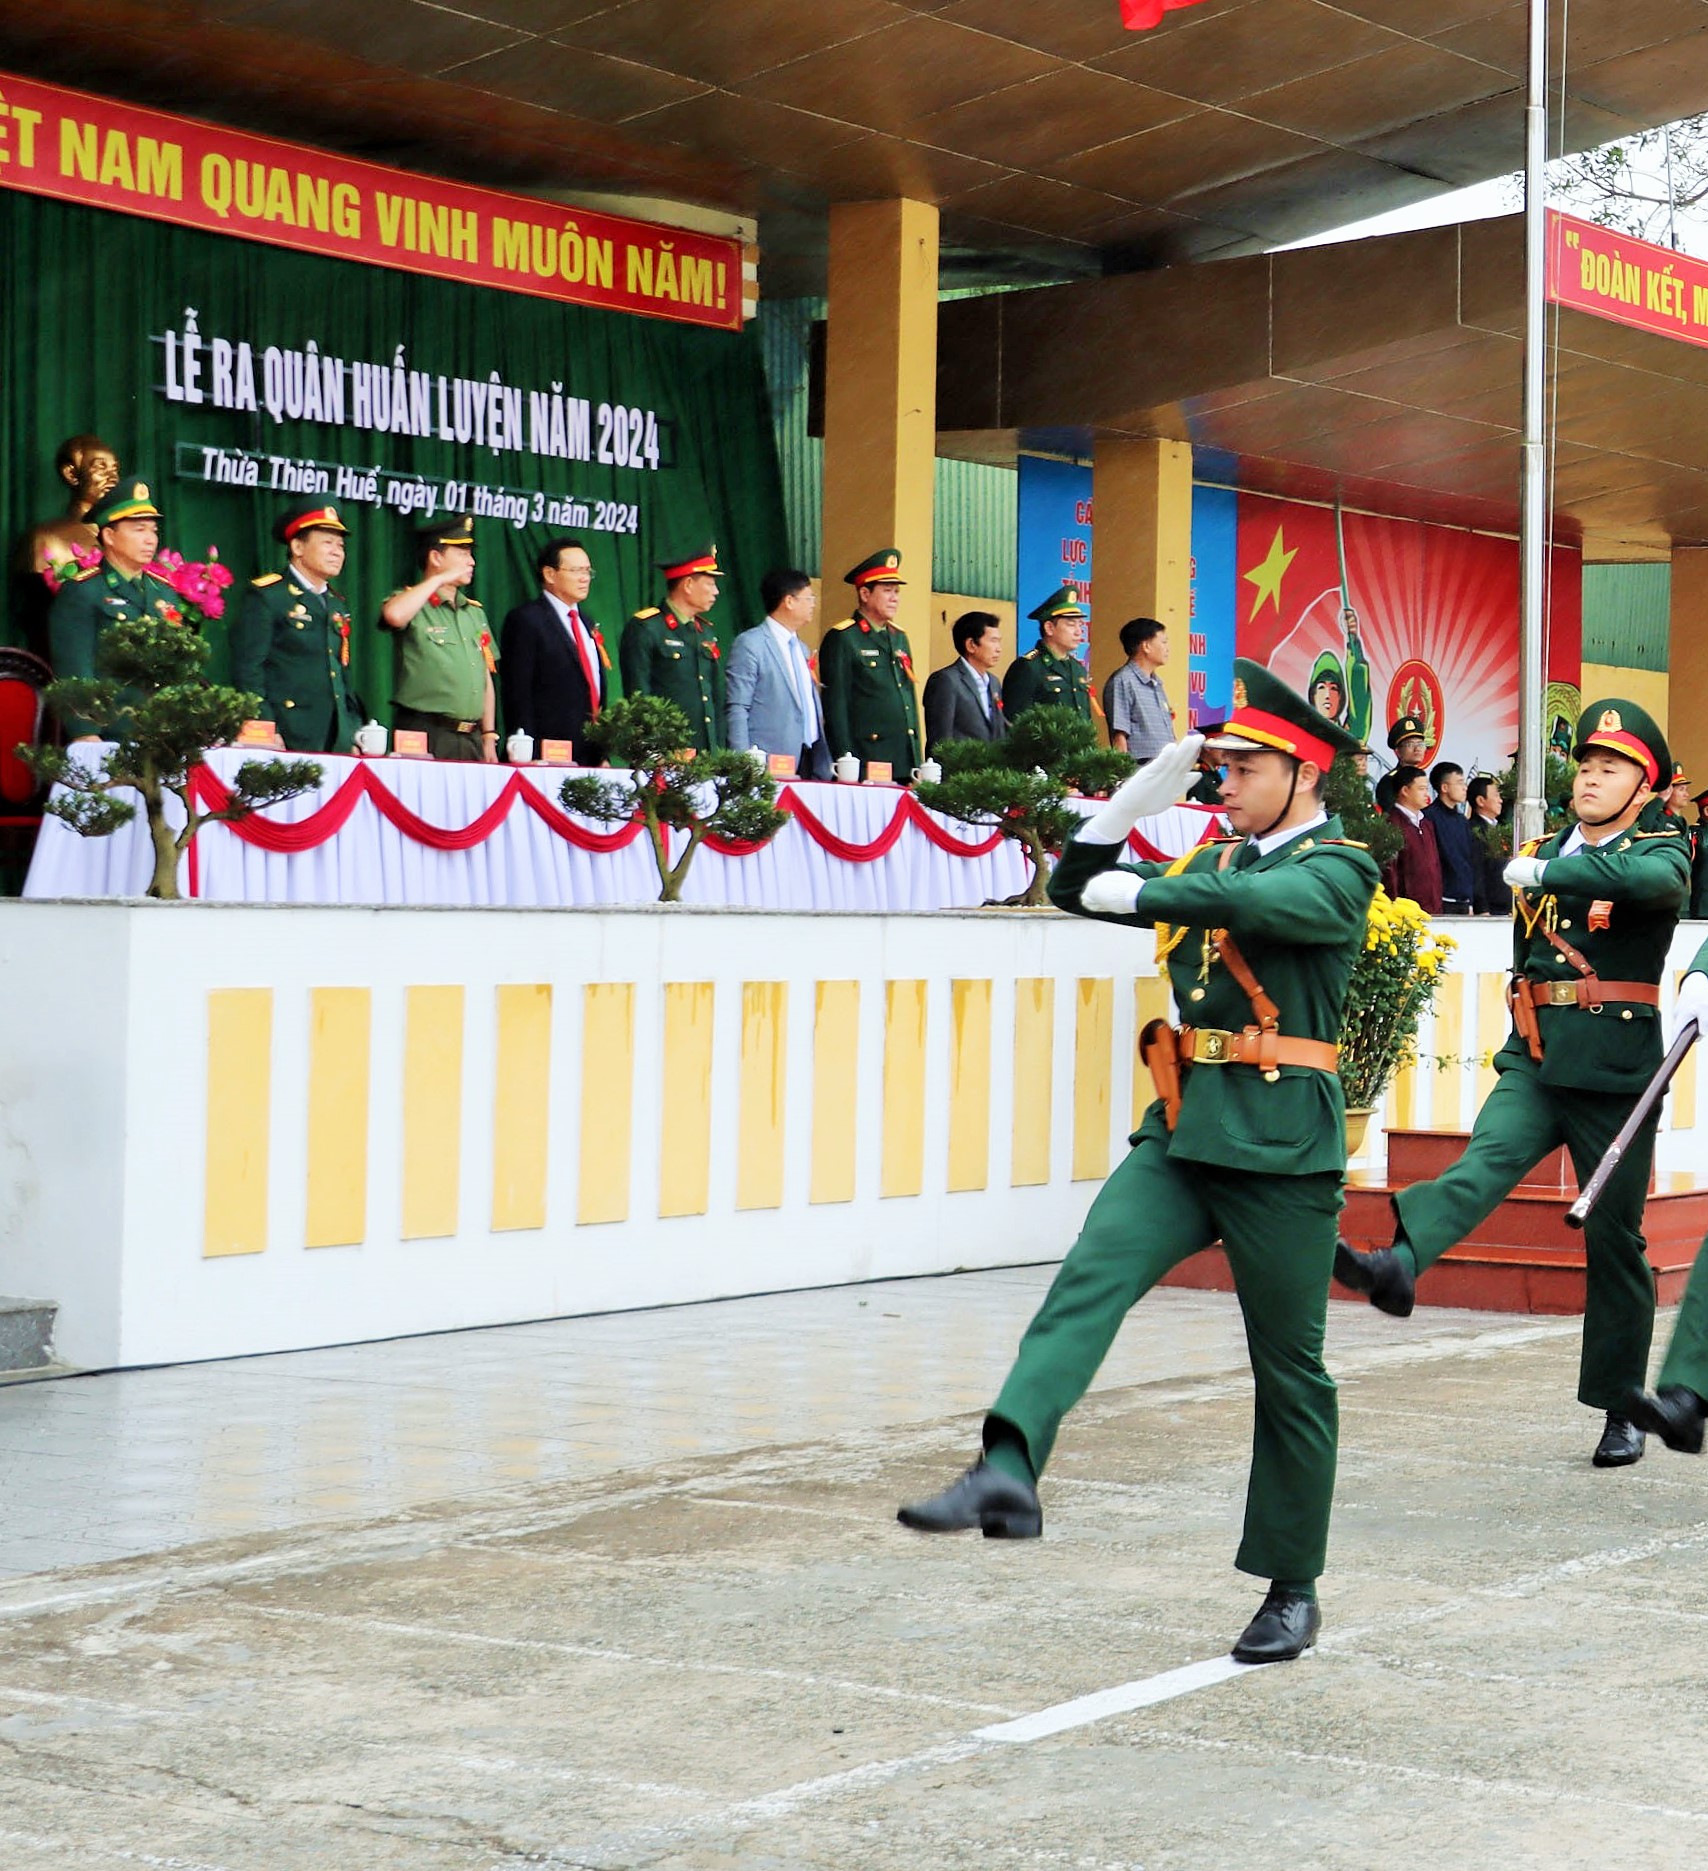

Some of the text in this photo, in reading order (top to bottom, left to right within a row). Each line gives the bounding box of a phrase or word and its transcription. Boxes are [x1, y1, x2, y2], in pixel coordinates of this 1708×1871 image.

[60, 117, 183, 201] NAM
[201, 152, 361, 240] QUANG
[375, 192, 478, 263] VINH
[492, 221, 614, 290] MUÔN
[627, 243, 727, 309] NĂM!
[1647, 264, 1687, 326] KẾT,
[165, 306, 661, 471] LỄ RA QUÂN HUẤN LUYỆN NĂM 2024
[201, 446, 638, 534] Thừa Thiên Huế, ngày 01 tháng 3 năm 2024
[1061, 537, 1087, 568] LỰC
